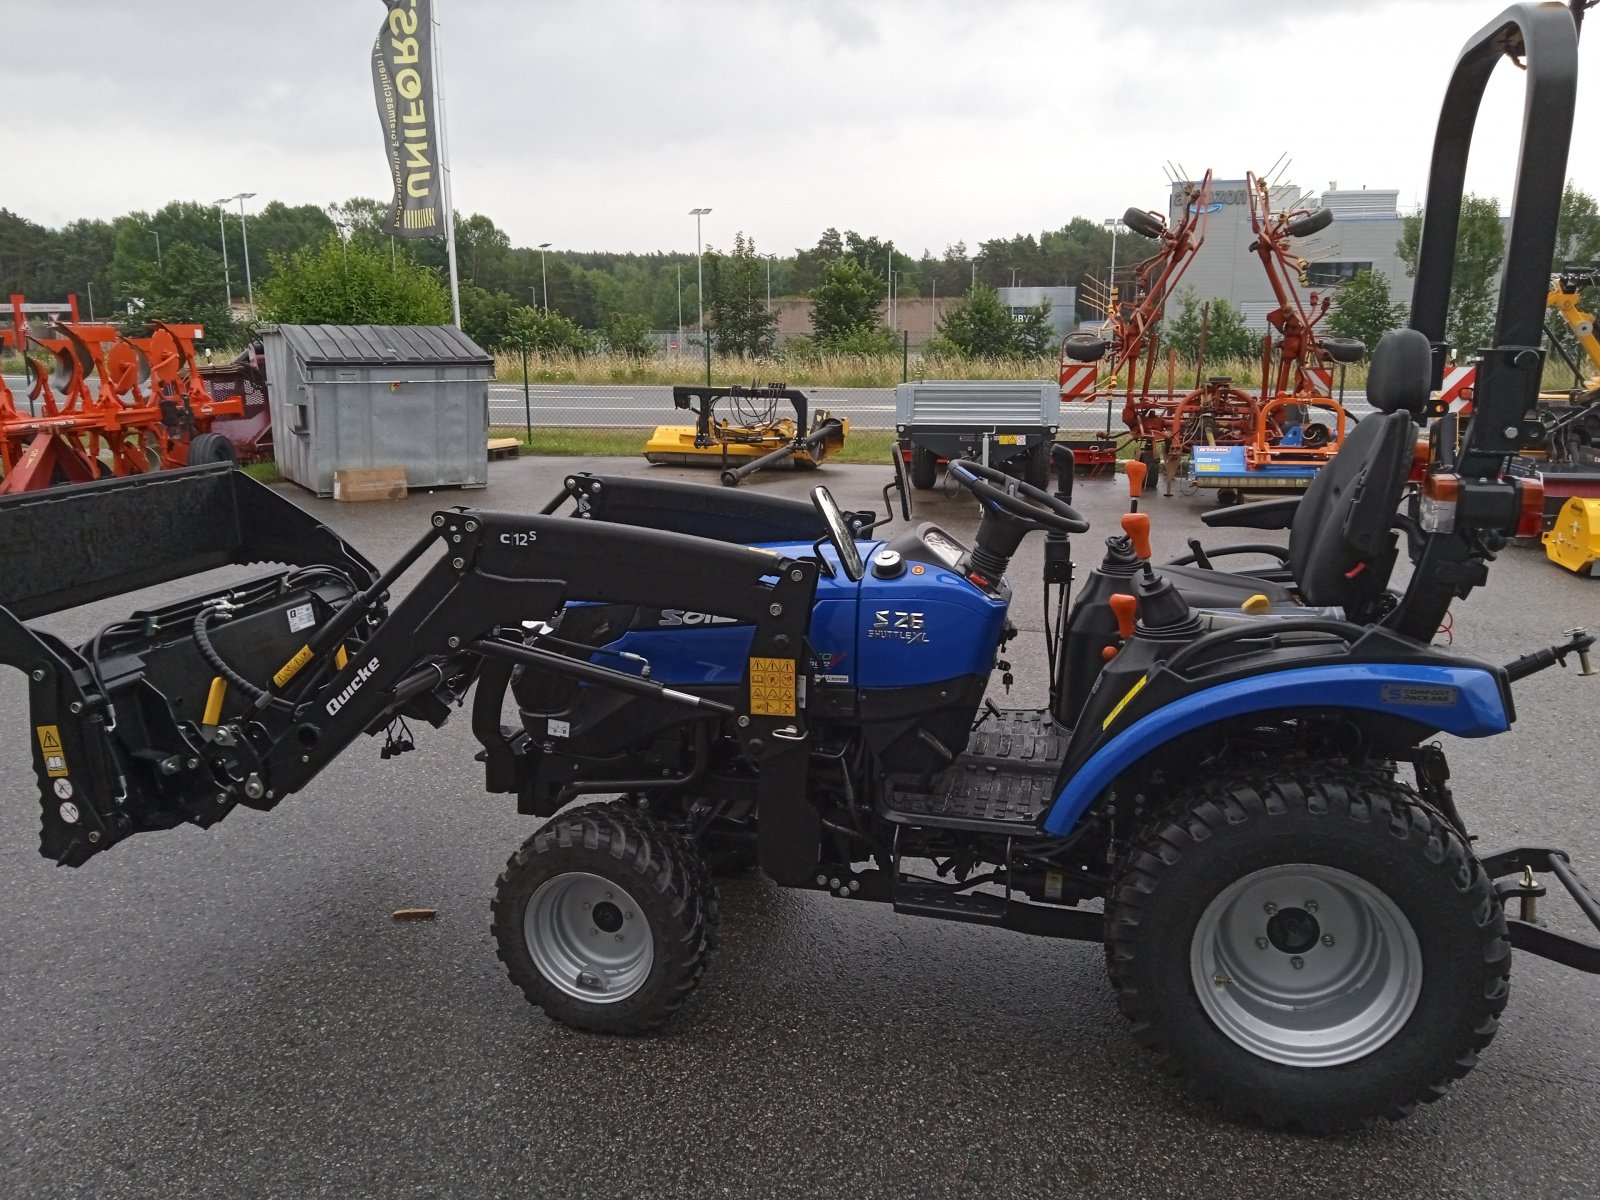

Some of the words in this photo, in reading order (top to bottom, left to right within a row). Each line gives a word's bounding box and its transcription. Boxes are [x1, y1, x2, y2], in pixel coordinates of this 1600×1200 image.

[894, 611, 925, 629] 26
[325, 656, 380, 716] Quicke
[1403, 688, 1449, 696] COMFORT
